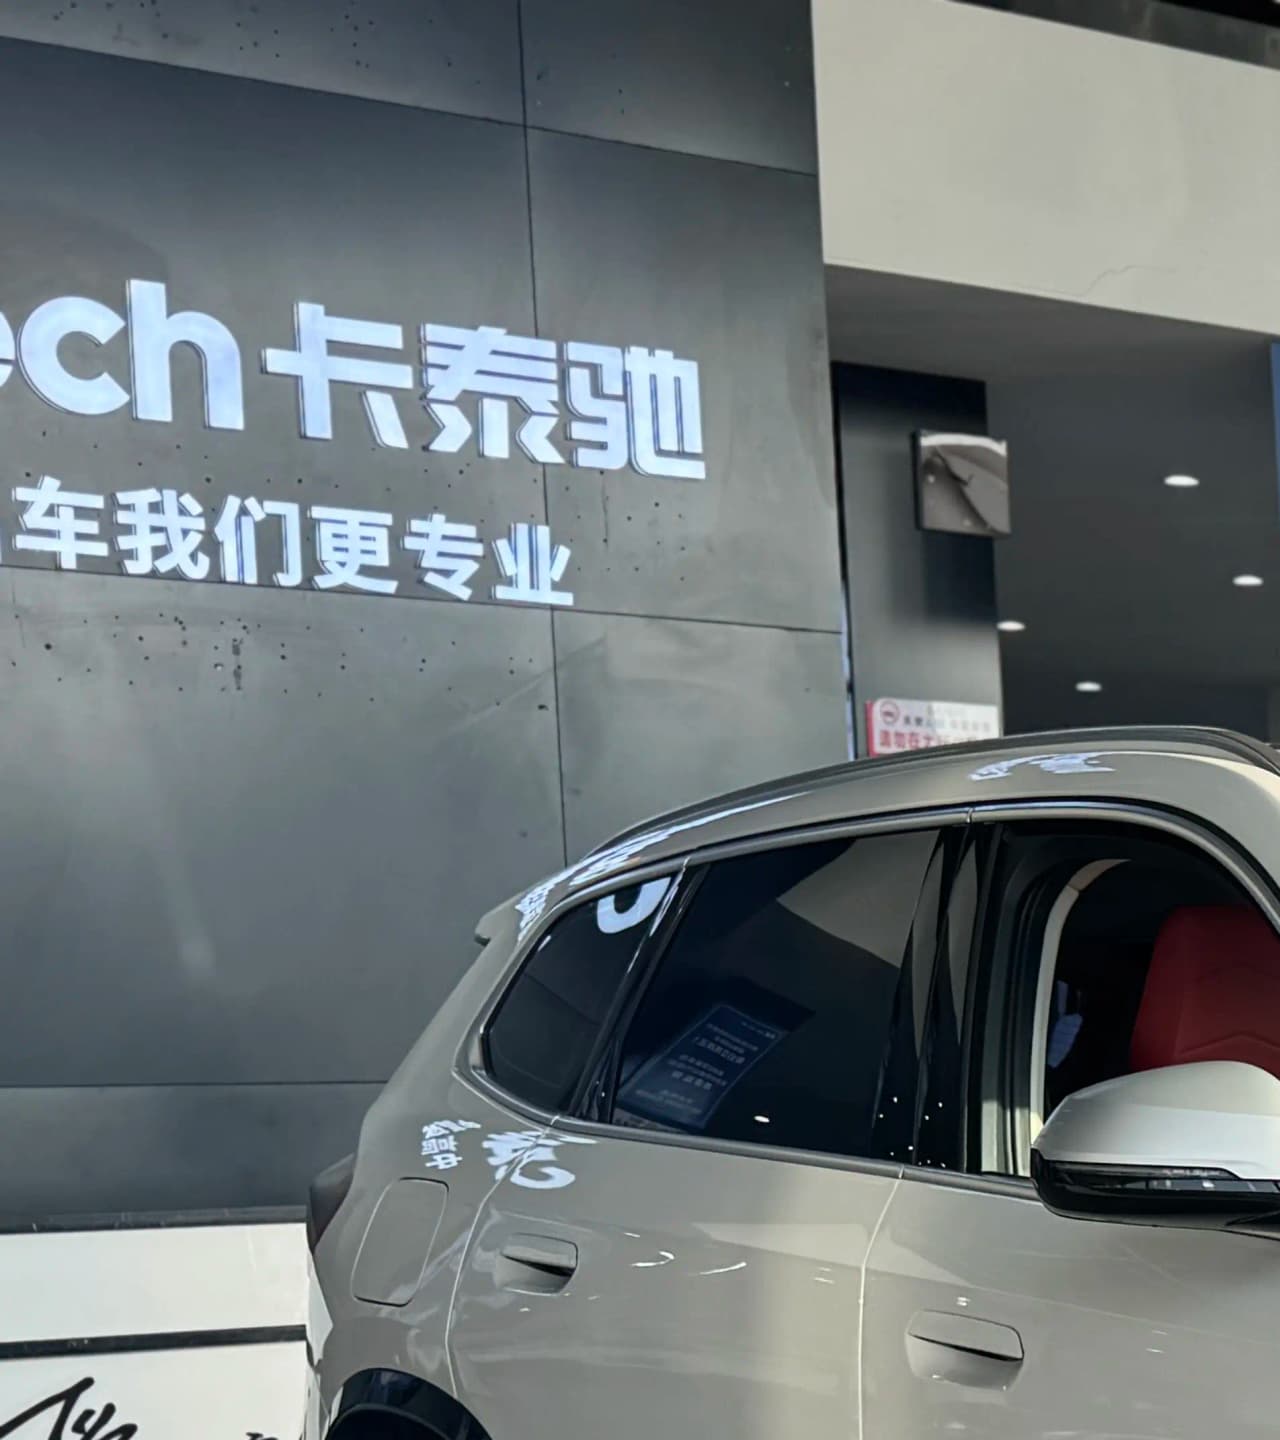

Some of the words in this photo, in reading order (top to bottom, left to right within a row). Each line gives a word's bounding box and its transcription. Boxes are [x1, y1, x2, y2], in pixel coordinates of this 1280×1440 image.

[0, 278, 244, 431] ch
[260, 301, 707, 480] 卡泰驰
[12, 475, 575, 606] 车我们更专业
